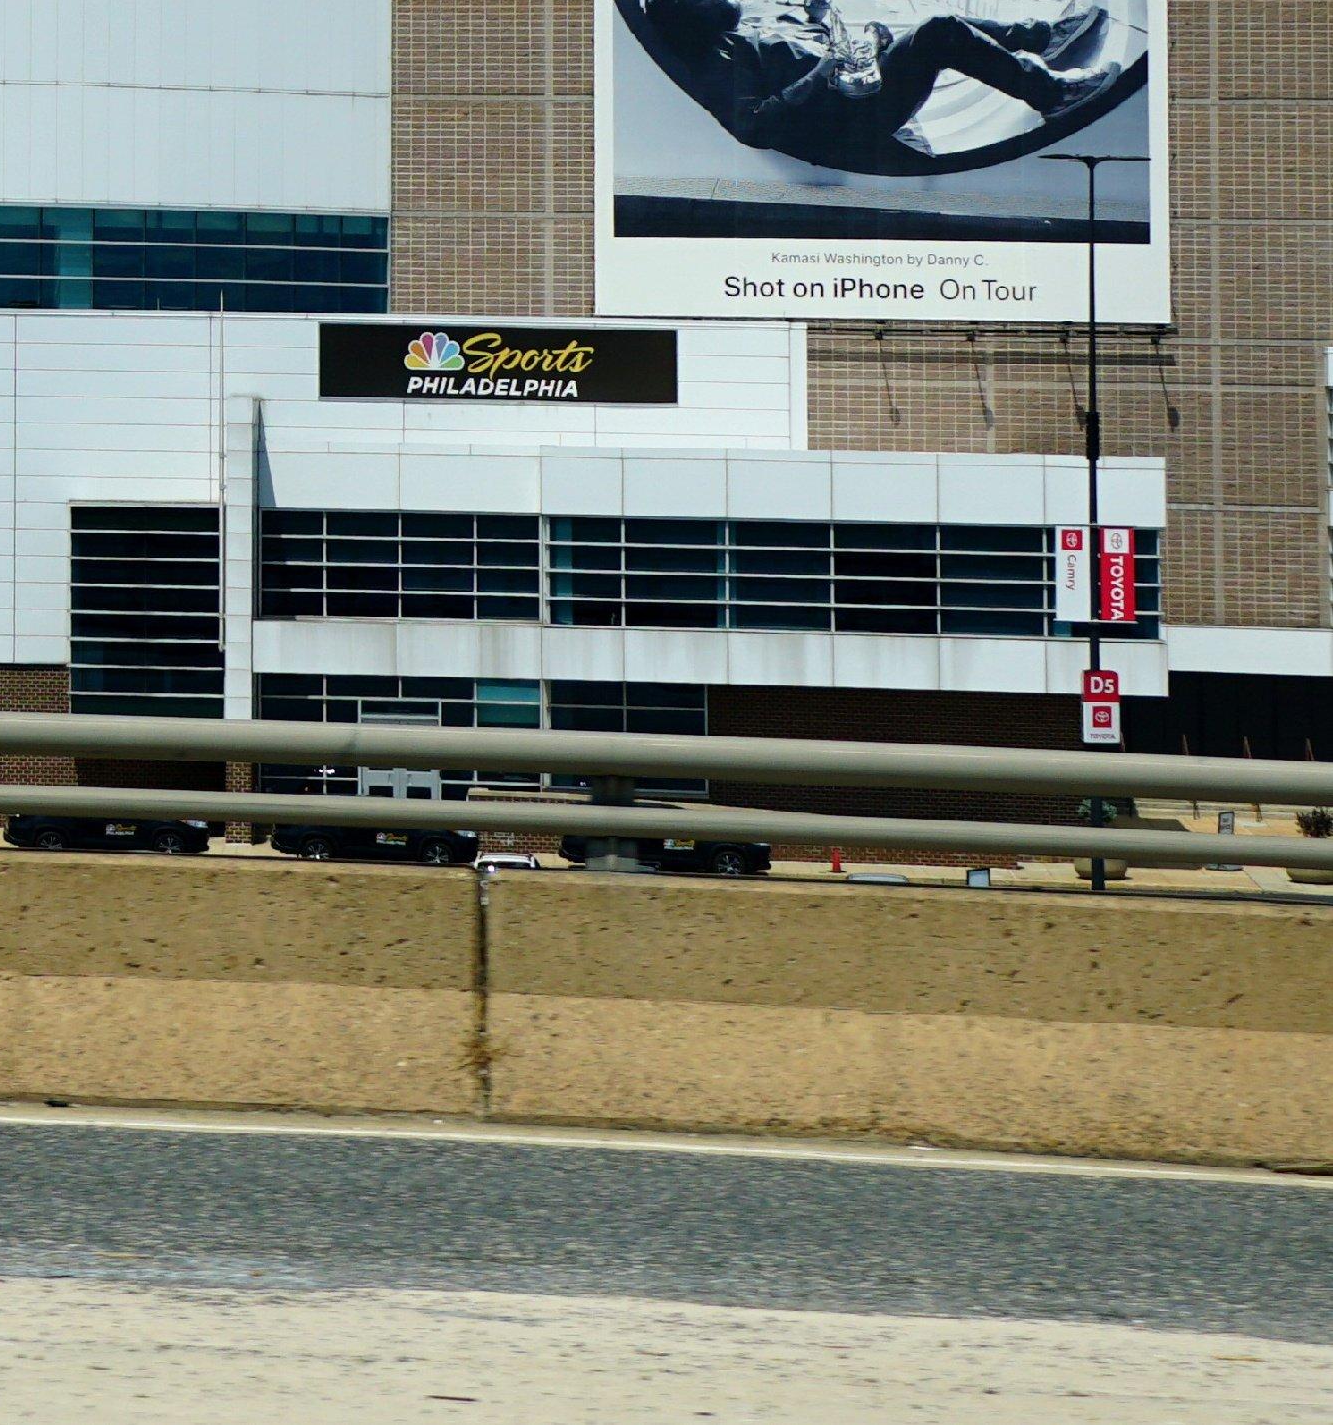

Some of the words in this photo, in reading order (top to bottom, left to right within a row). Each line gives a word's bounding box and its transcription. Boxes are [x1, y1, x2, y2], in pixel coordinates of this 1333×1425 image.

[771, 252, 820, 264] Kamasi
[824, 252, 903, 267] Washington
[907, 253, 923, 267] by
[927, 254, 970, 267] Danny
[974, 254, 989, 266] C.
[724, 276, 785, 298] Shot
[793, 281, 824, 298] on
[833, 278, 925, 301] iPhone
[939, 279, 976, 301] On
[982, 280, 1037, 302] Tour
[462, 332, 594, 380] Sports
[406, 376, 579, 398] PHILADELPHIA
[1066, 554, 1076, 591] Camry
[1109, 556, 1125, 620] TOYOTA
[1090, 676, 1115, 693] D5
